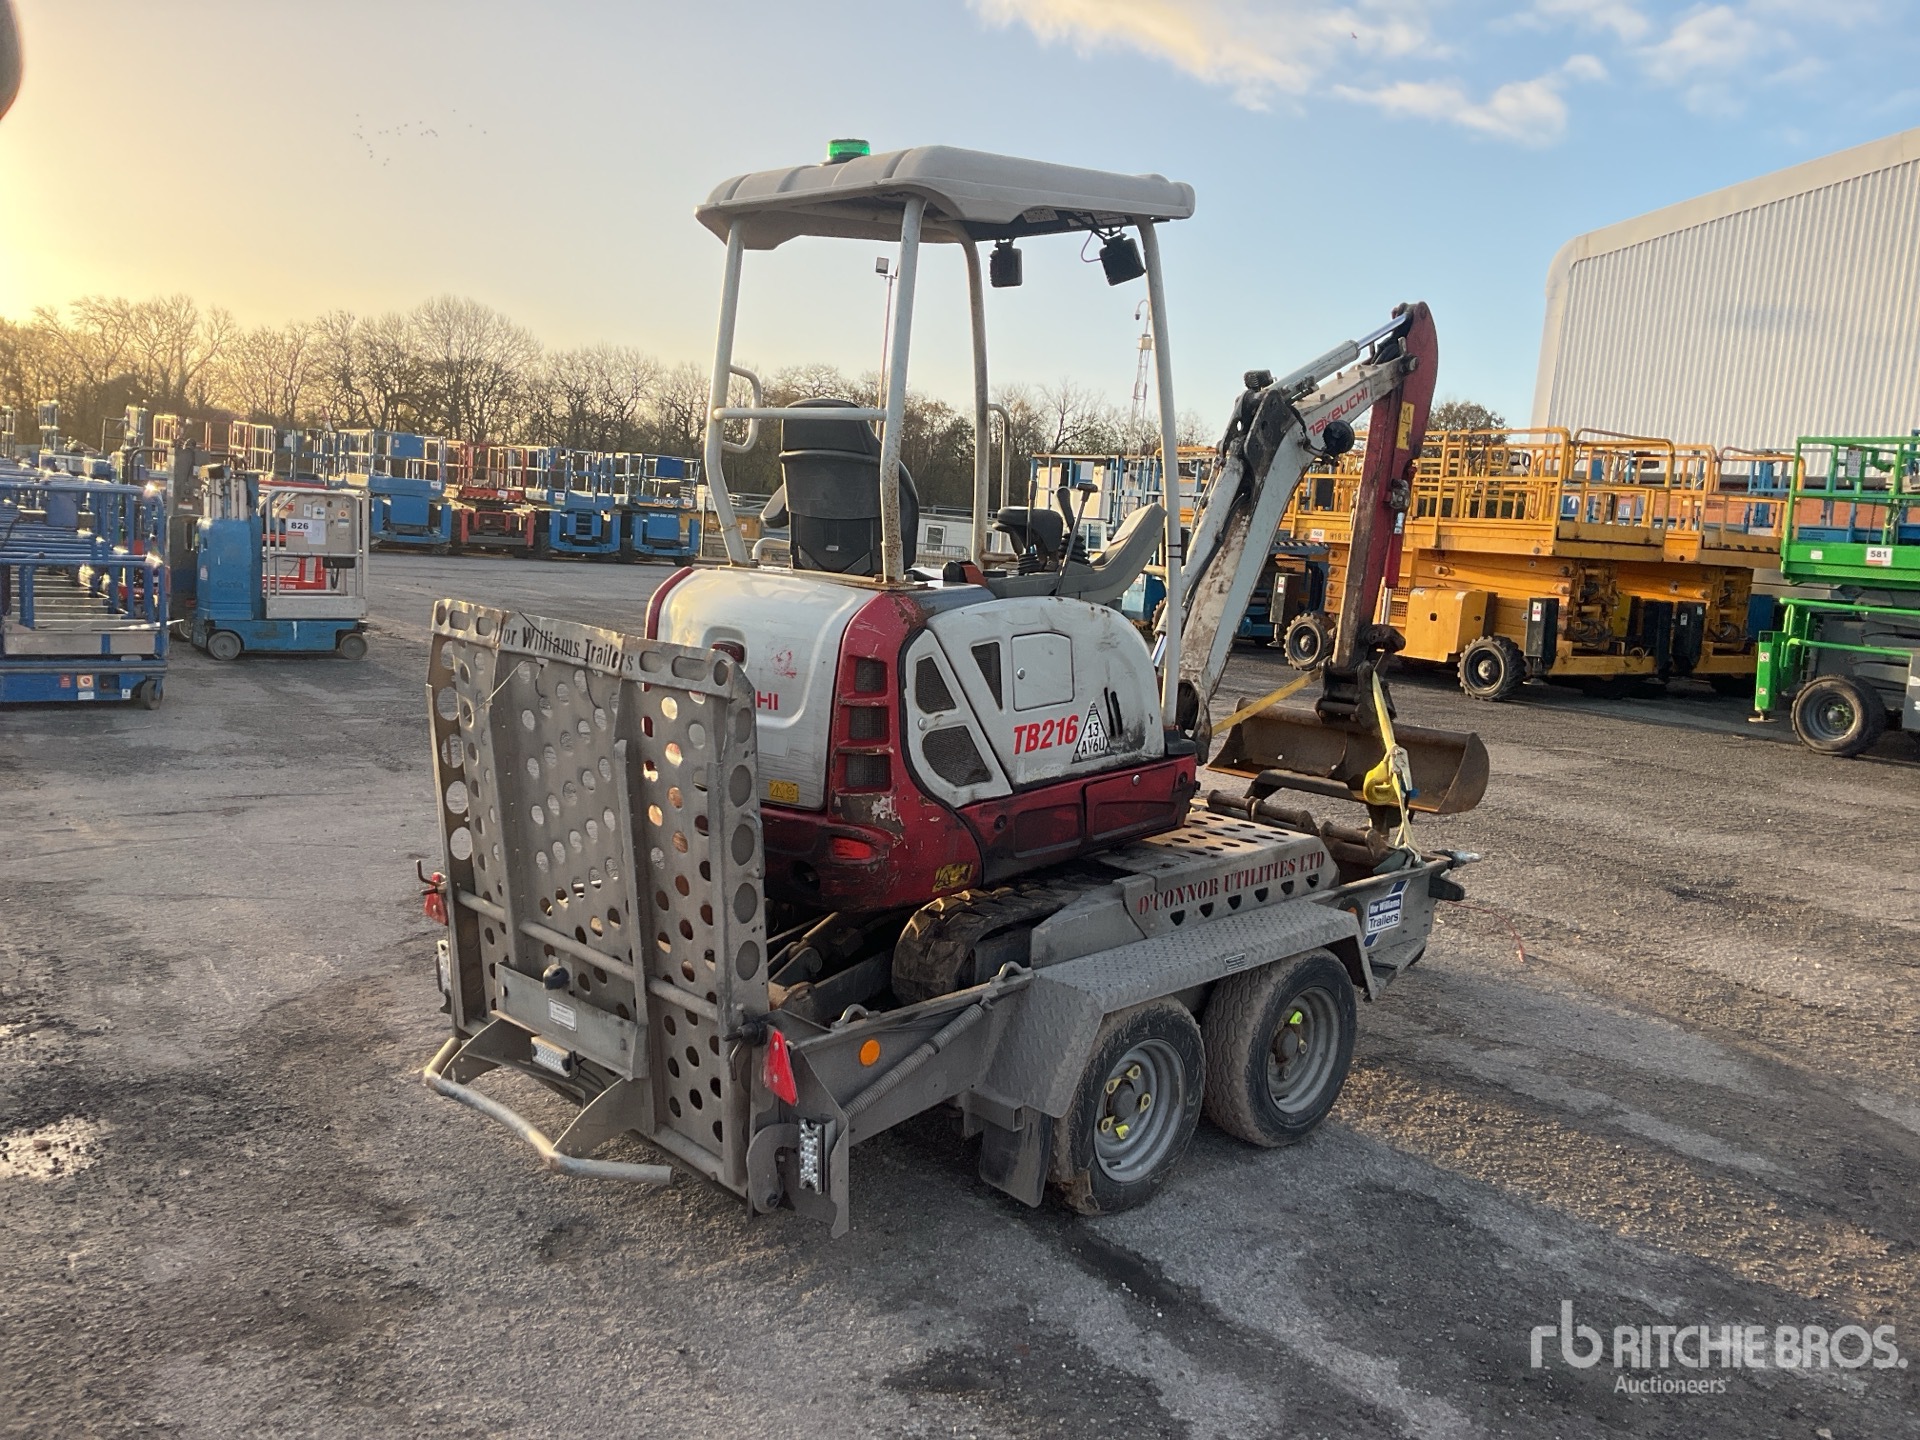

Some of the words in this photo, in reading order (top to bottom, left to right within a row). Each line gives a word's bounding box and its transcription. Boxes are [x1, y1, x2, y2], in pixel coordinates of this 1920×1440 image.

[291, 522, 309, 530] 826
[1870, 550, 1888, 558] 581
[522, 626, 580, 657] Williams
[585, 638, 633, 671] Trailers
[1013, 714, 1079, 755] TB216
[1088, 722, 1099, 738] 13
[1137, 877, 1219, 915] O'CONNOR
[1223, 858, 1296, 893] UTILITIES
[1299, 851, 1325, 873] LTD
[1369, 912, 1399, 929] Trailers
